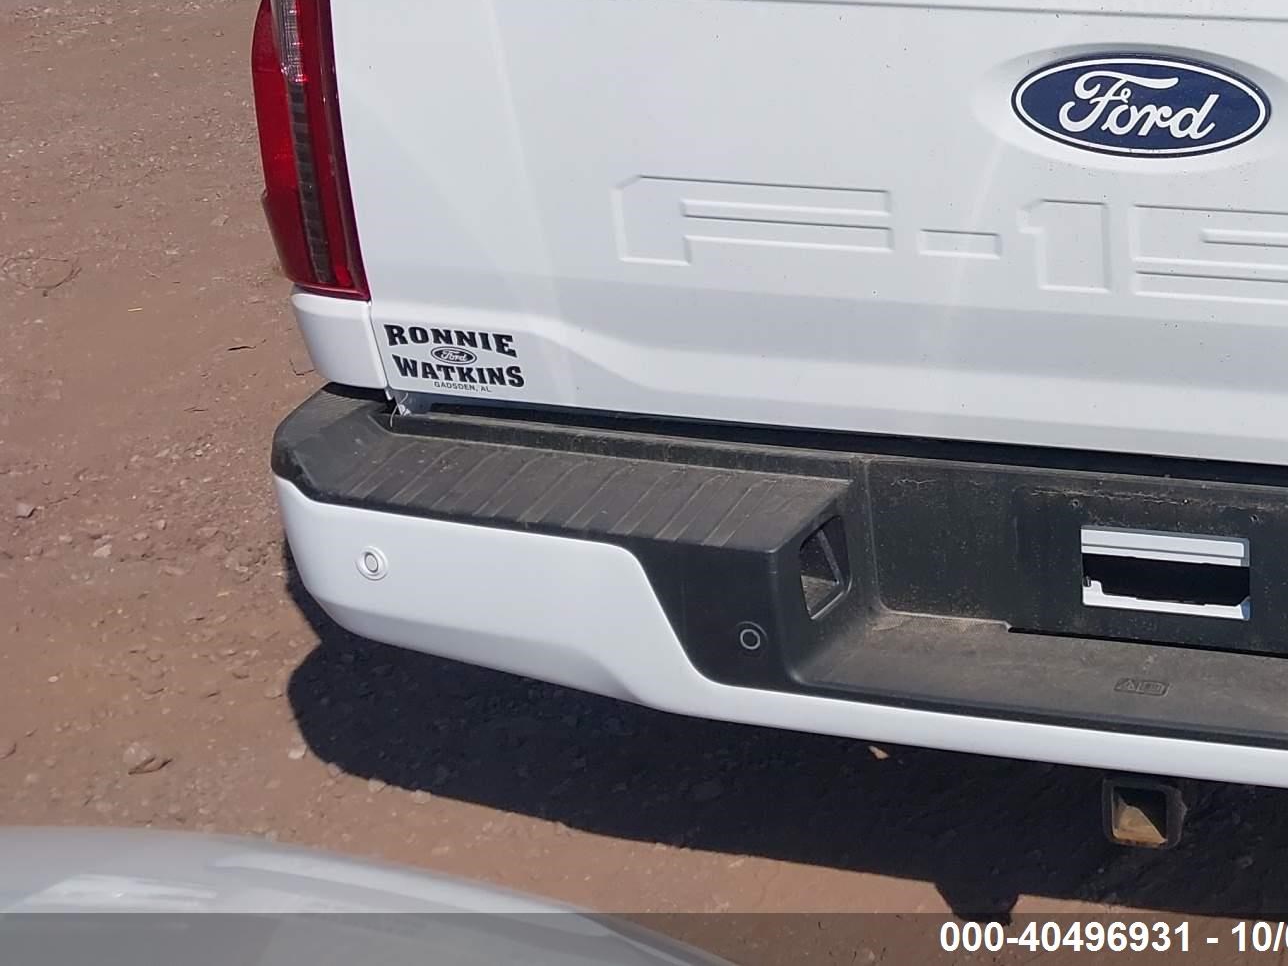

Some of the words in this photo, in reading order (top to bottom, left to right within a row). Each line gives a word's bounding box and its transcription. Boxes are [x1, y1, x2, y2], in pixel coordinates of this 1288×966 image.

[1059, 70, 1219, 139] Ford
[384, 324, 517, 358] RONNIE
[392, 354, 525, 388] WATKINS
[480, 385, 492, 393] AL
